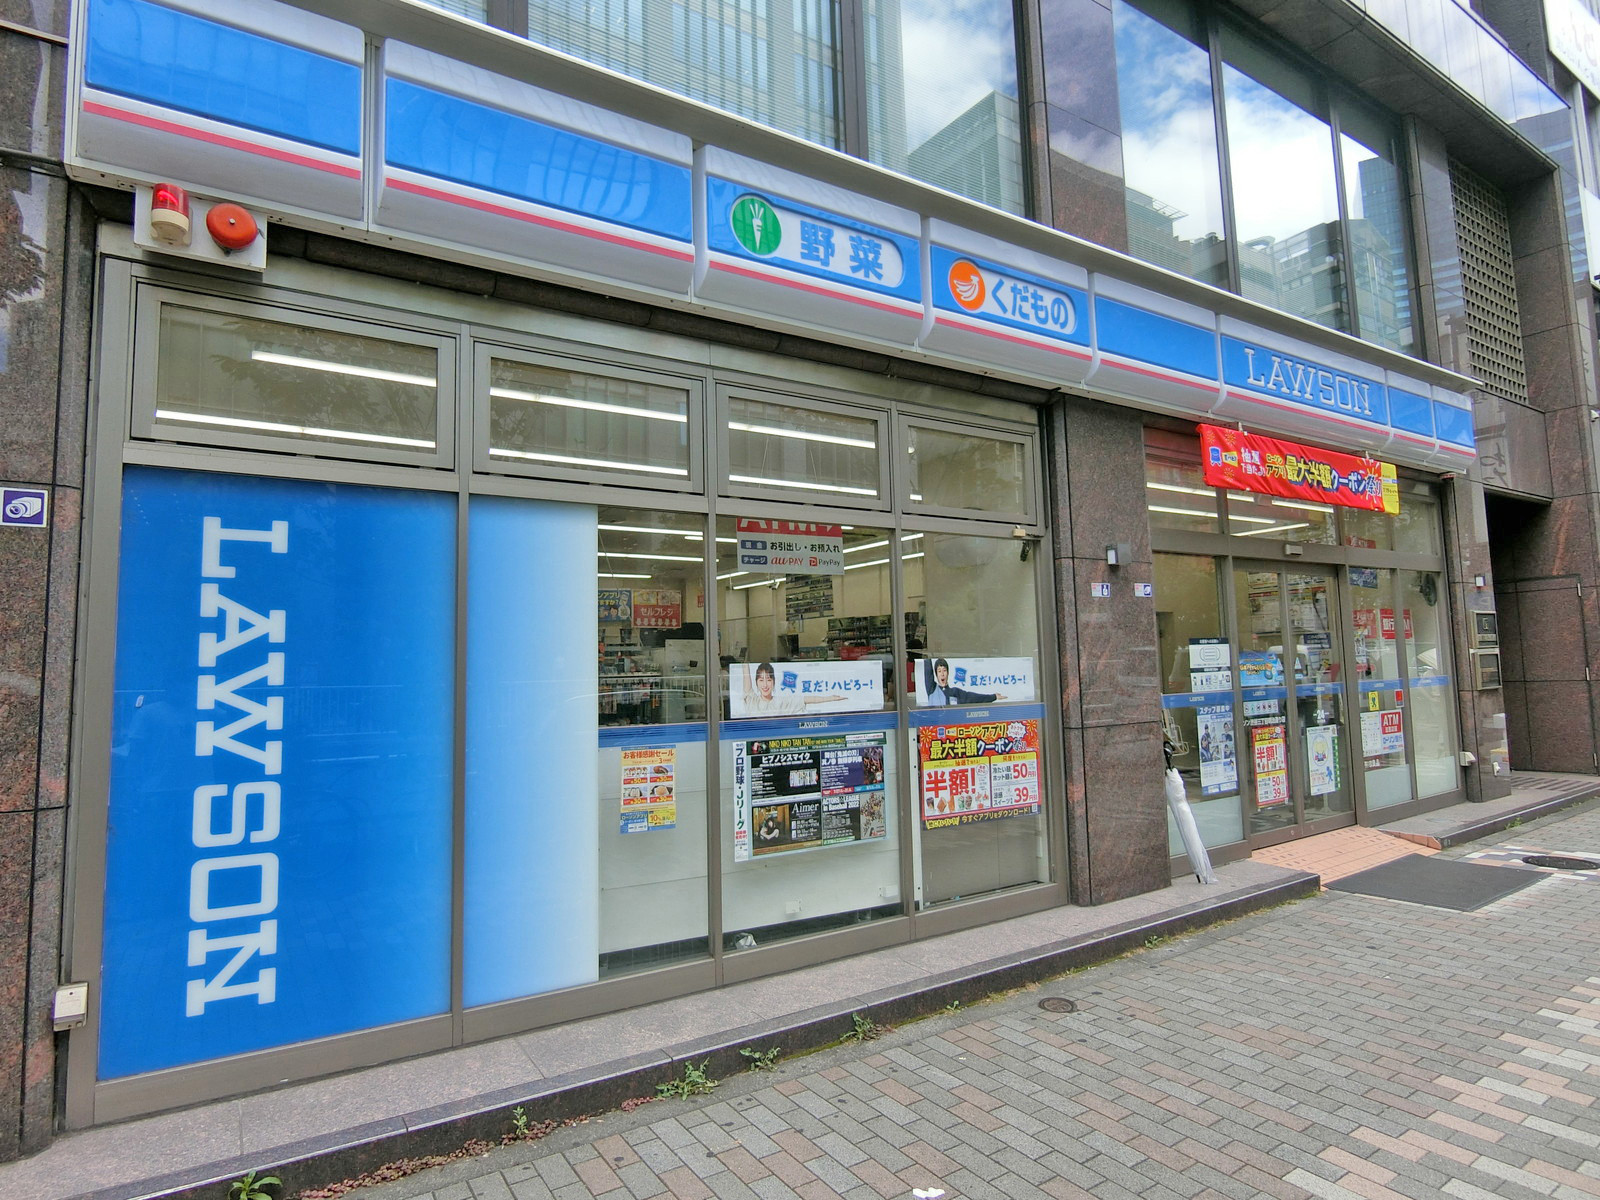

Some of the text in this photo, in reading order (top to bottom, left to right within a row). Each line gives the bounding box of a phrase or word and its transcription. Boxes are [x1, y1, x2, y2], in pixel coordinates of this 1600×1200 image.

[799, 220, 884, 281] 野菜
[990, 279, 1070, 330] くだもの
[1244, 348, 1372, 416] LAWSON
[818, 559, 841, 567] PayPay
[640, 607, 674, 617] セルフレジ
[1383, 714, 1399, 726] ATM
[186, 516, 289, 1018] LAWSON
[761, 752, 811, 764] ヒプノシスマイク
[1012, 762, 1028, 780] 50
[735, 748, 745, 830] プロ野球・Jリーグ
[925, 767, 977, 799] 半額!
[1013, 786, 1029, 804] 39
[791, 802, 820, 814] Aimer
